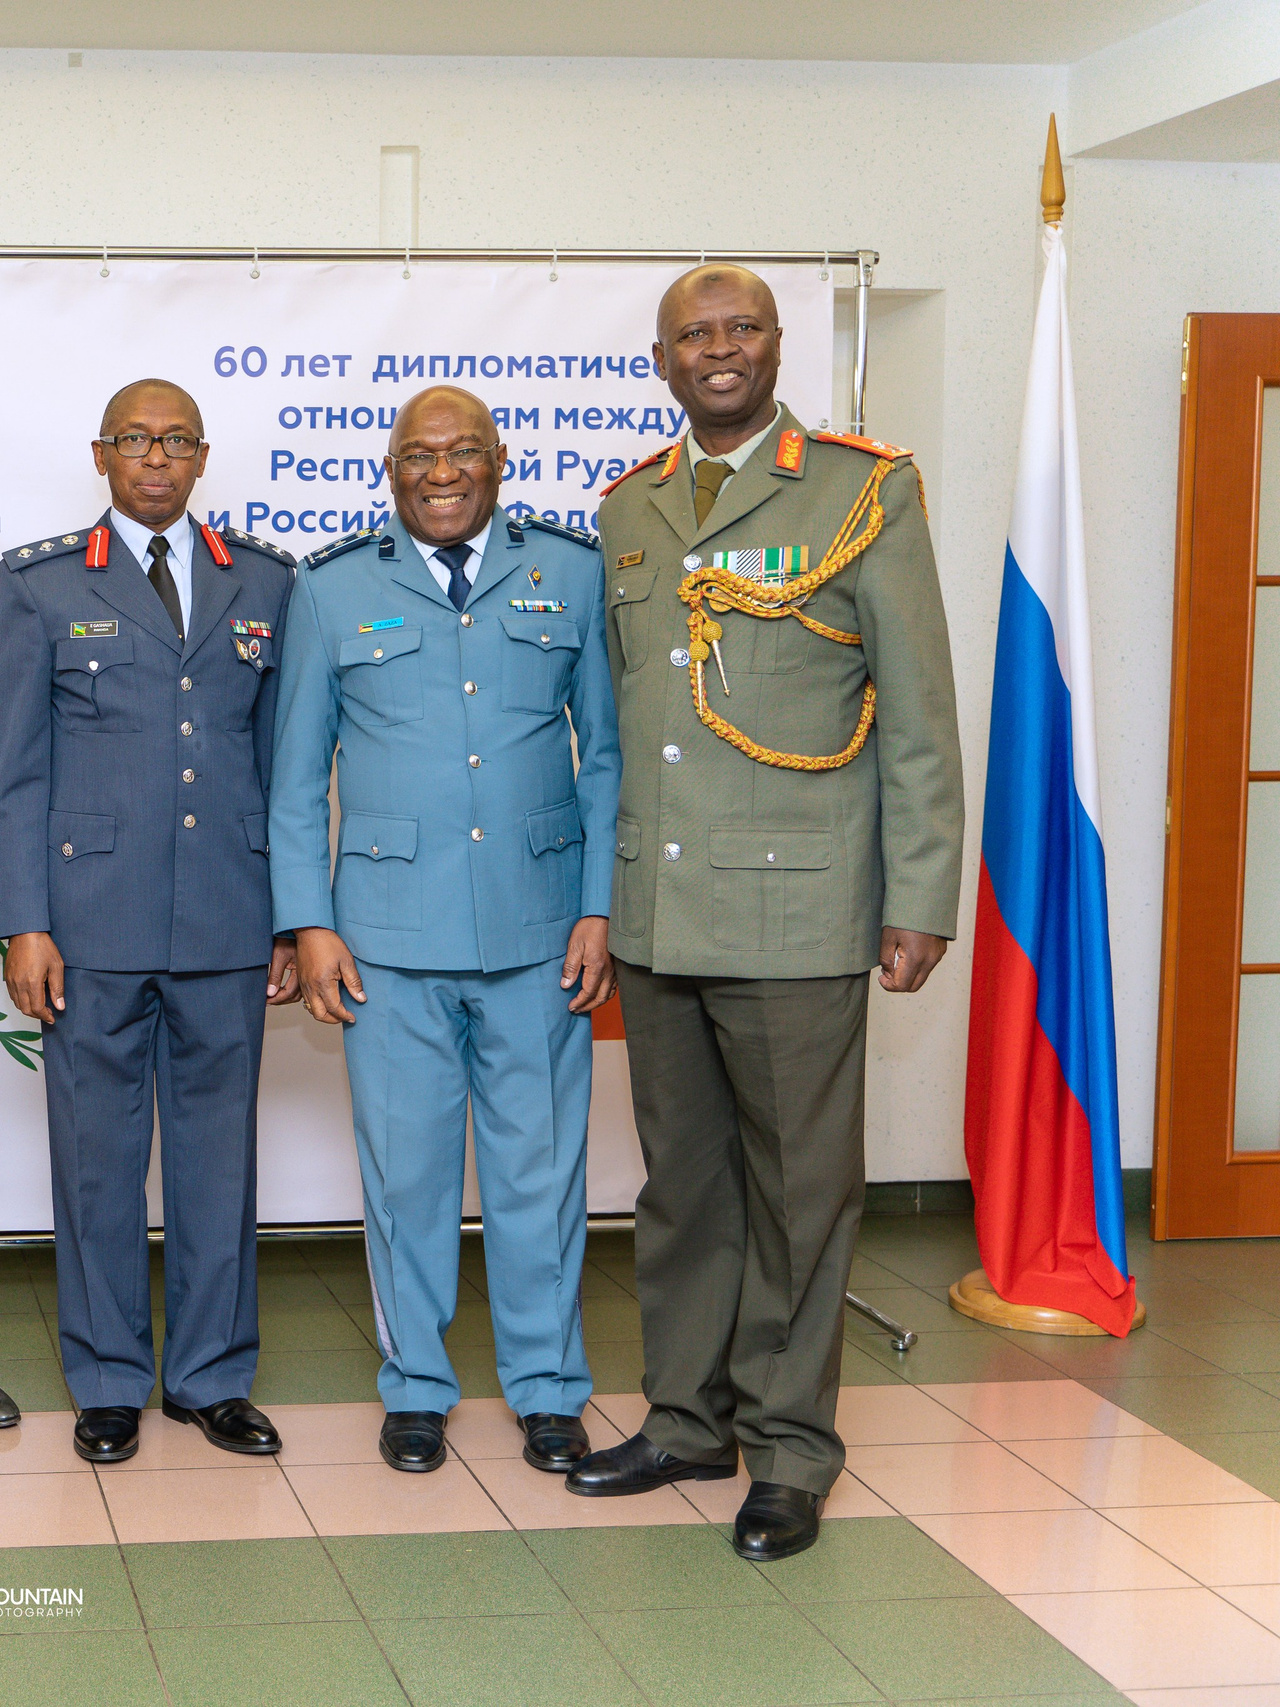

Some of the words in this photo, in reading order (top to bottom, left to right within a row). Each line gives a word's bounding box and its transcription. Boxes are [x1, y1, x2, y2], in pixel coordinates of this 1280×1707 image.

[214, 345, 268, 378] 60
[281, 354, 352, 378] лет
[554, 406, 687, 438] между
[208, 510, 230, 532] и
[245, 500, 391, 534] Россий
